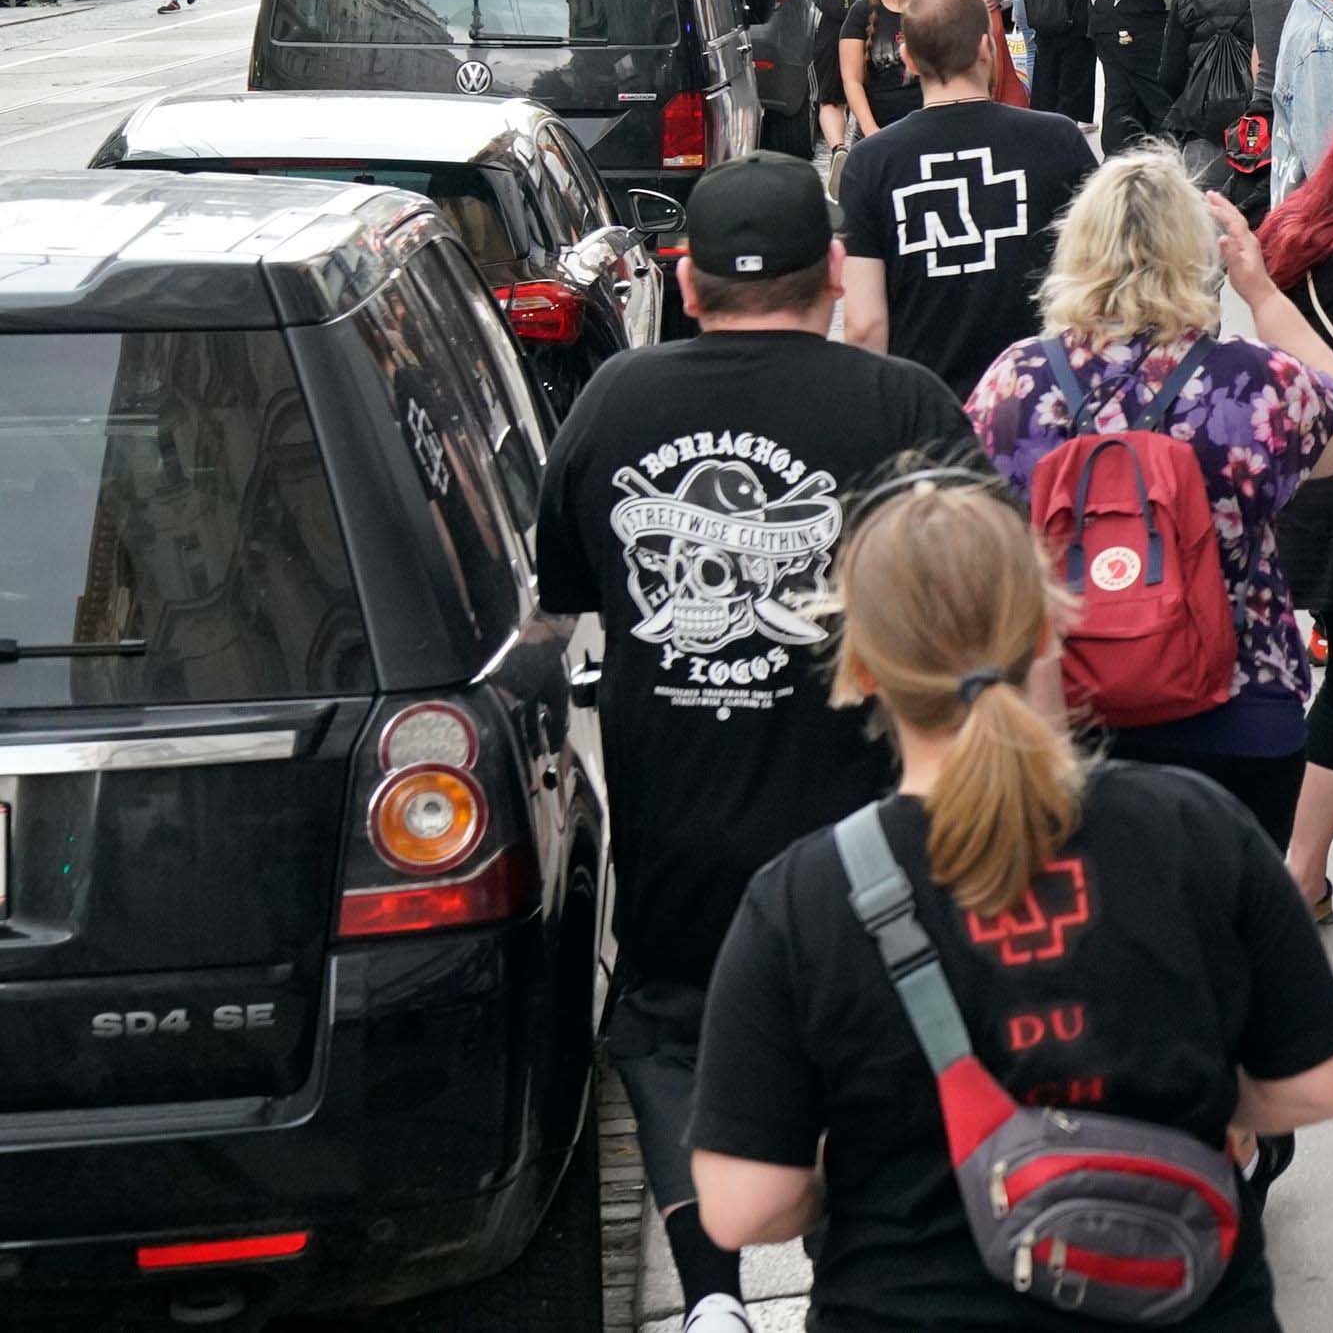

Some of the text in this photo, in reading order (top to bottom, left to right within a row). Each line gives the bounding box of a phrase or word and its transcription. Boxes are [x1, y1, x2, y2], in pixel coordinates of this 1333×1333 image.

[639, 429, 807, 485] BORRACHOS
[738, 524, 823, 553] CLOTHING
[91, 1003, 276, 1038] SD4 SE
[1009, 1005, 1086, 1051] DU
